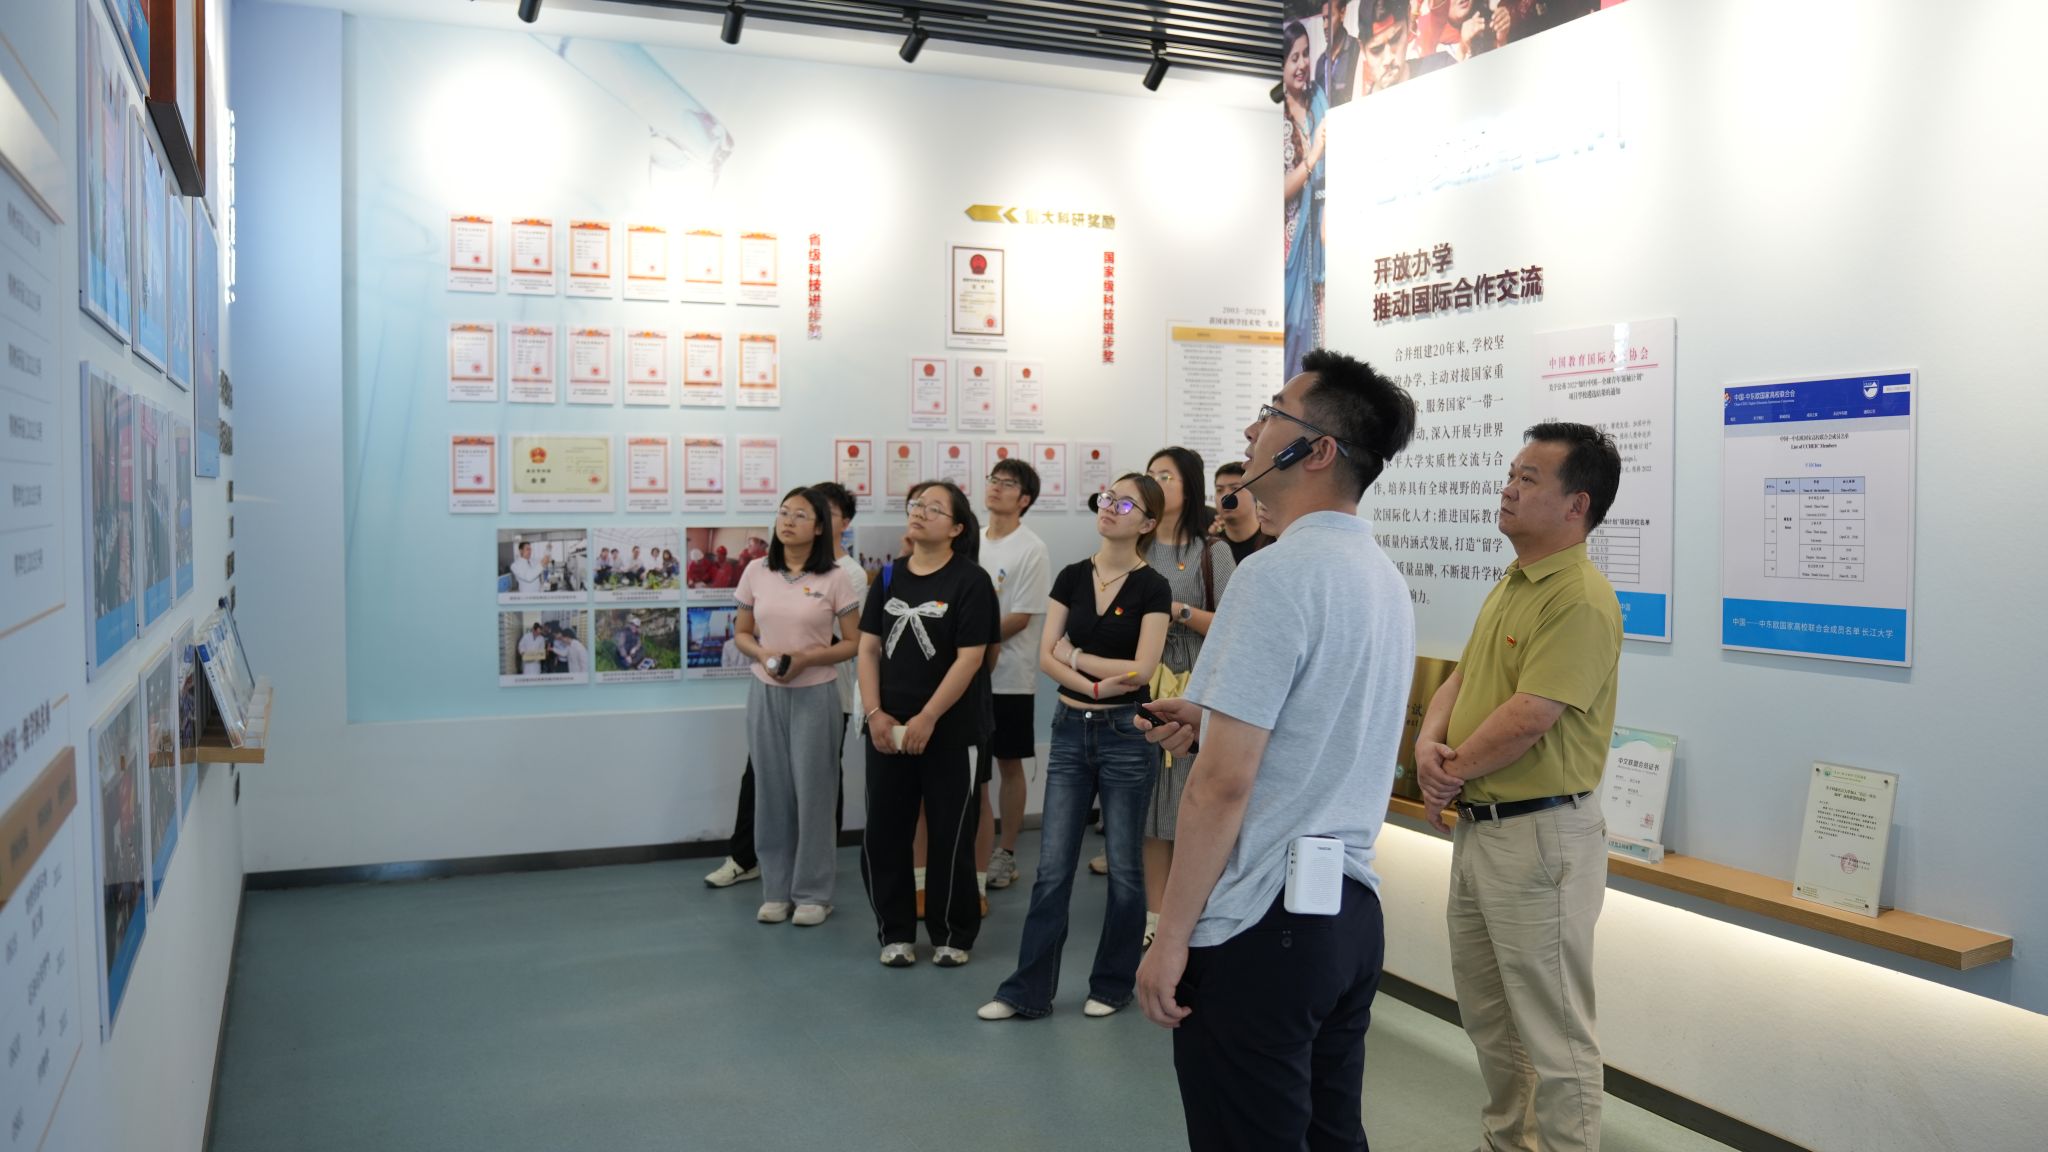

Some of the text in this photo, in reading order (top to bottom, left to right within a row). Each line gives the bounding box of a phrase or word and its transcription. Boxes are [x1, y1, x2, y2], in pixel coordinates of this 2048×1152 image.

[1374, 243, 1454, 285] 开放办学
[1373, 265, 1544, 322] 推动国际合作交流
[1103, 251, 1115, 364] 国家级科技进步奖
[1549, 346, 1649, 370] 中国教育国际交协会
[1409, 422, 1503, 441] 动，深入开展与世界
[1374, 480, 1503, 496] 作，培养具有全球视野的高层
[1862, 628, 1894, 639] 长江大学
